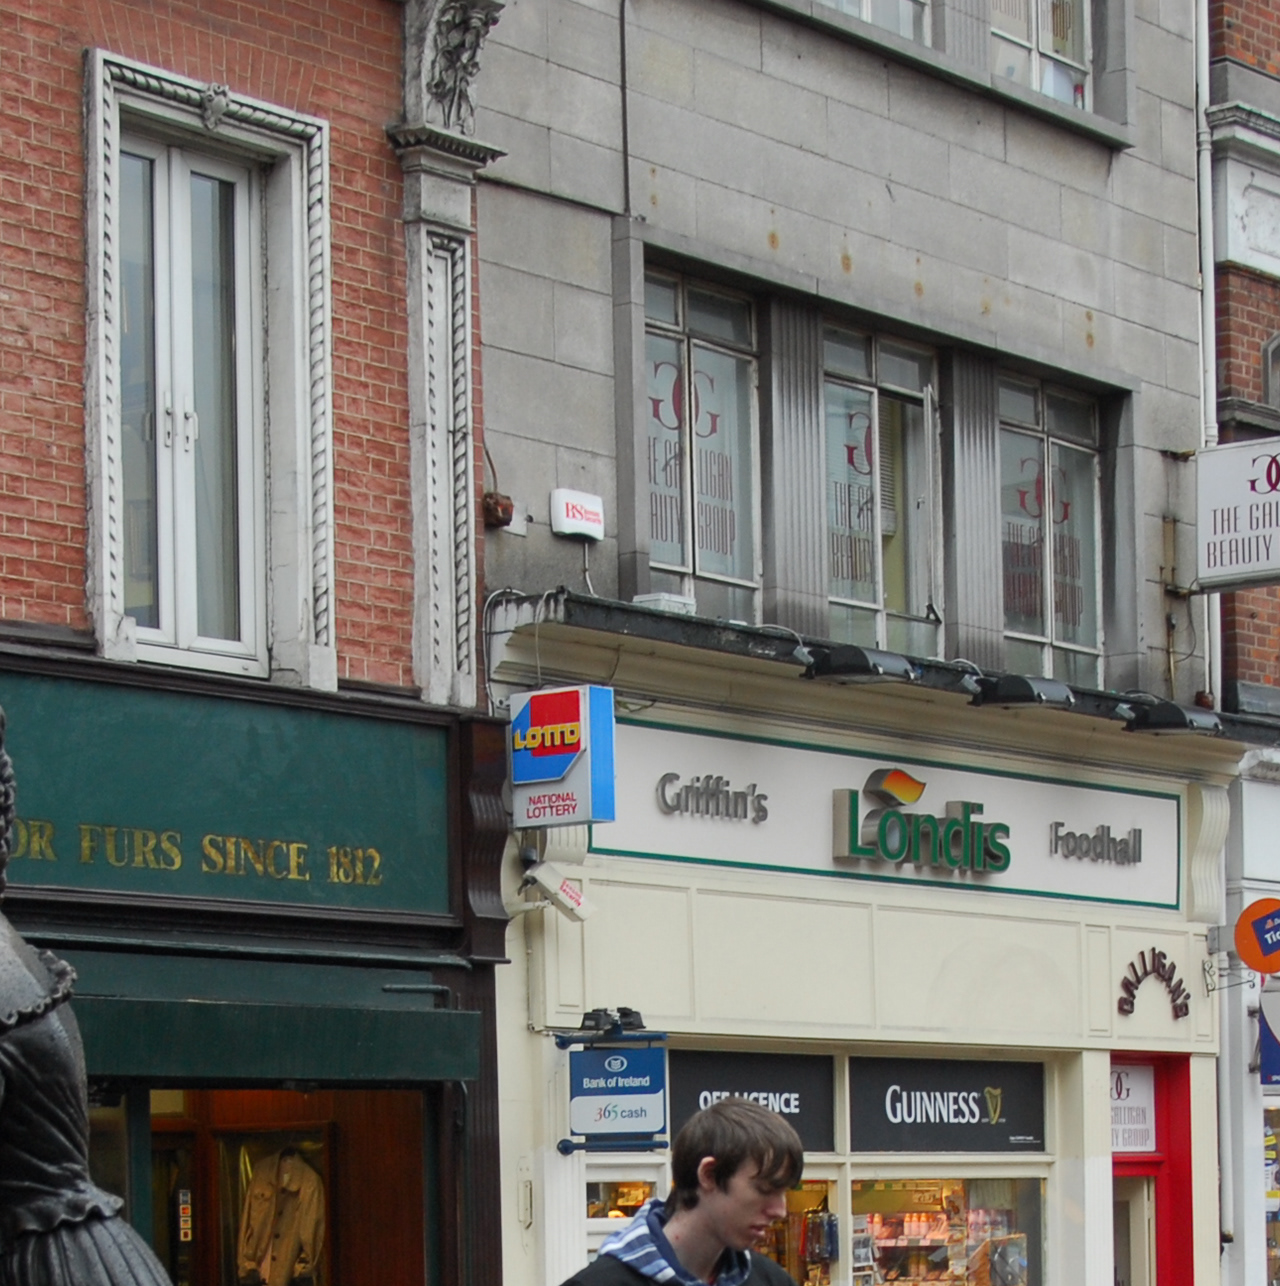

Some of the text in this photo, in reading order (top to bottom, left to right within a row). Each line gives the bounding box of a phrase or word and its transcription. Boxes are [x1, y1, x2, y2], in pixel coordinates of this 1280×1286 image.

[833, 481, 852, 529] THE
[1211, 505, 1241, 536] THE
[697, 501, 736, 556] GROUP
[1207, 534, 1273, 568] BEAUTY
[514, 721, 581, 750] LOTTO
[526, 803, 578, 819] LOTTERY
[528, 792, 577, 806] NATIONAL
[655, 772, 769, 823] Griffin's
[832, 788, 1013, 874] Londis
[1050, 821, 1143, 866] Foodhall
[9, 817, 383, 886] OR FURS SINCE 1812
[583, 1075, 650, 1089] Bank of Ireland
[594, 1102, 647, 1122] 365 cash
[733, 1091, 800, 1113] CENCE
[885, 1085, 981, 1124] GUINNESS
[1122, 1128, 1149, 1147] GROUP
